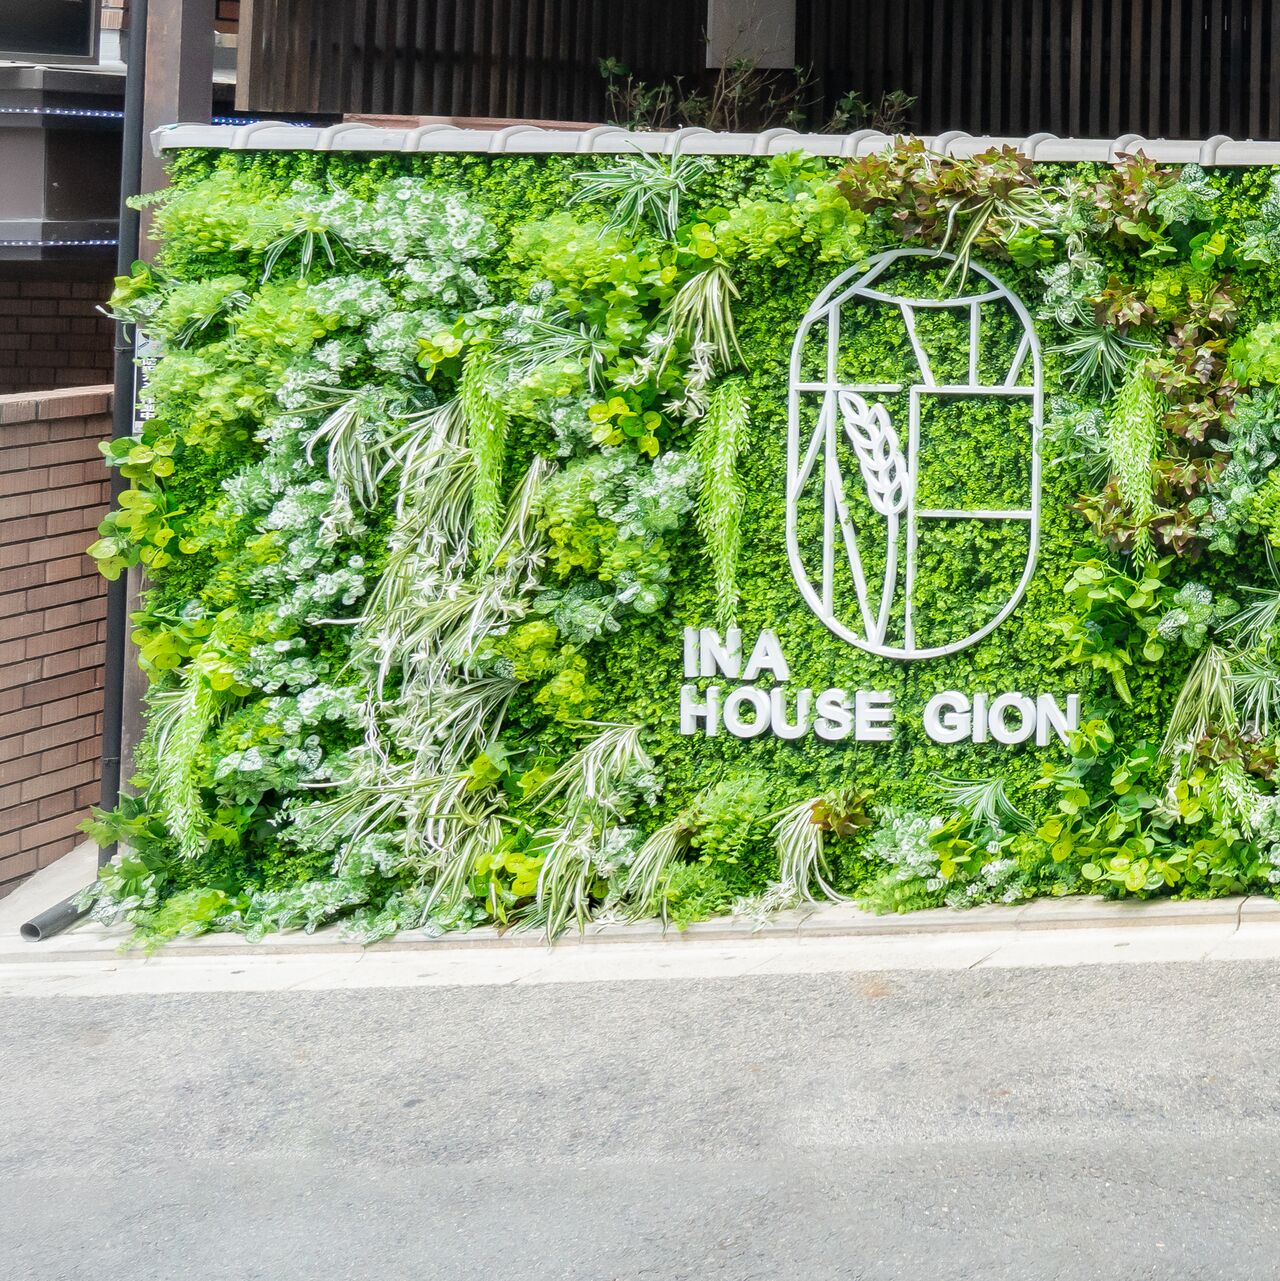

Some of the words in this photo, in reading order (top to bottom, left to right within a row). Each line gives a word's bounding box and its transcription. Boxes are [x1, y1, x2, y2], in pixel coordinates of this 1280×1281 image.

[683, 626, 791, 681] INA
[679, 684, 896, 742] HOUSE
[923, 690, 1080, 747] GION
